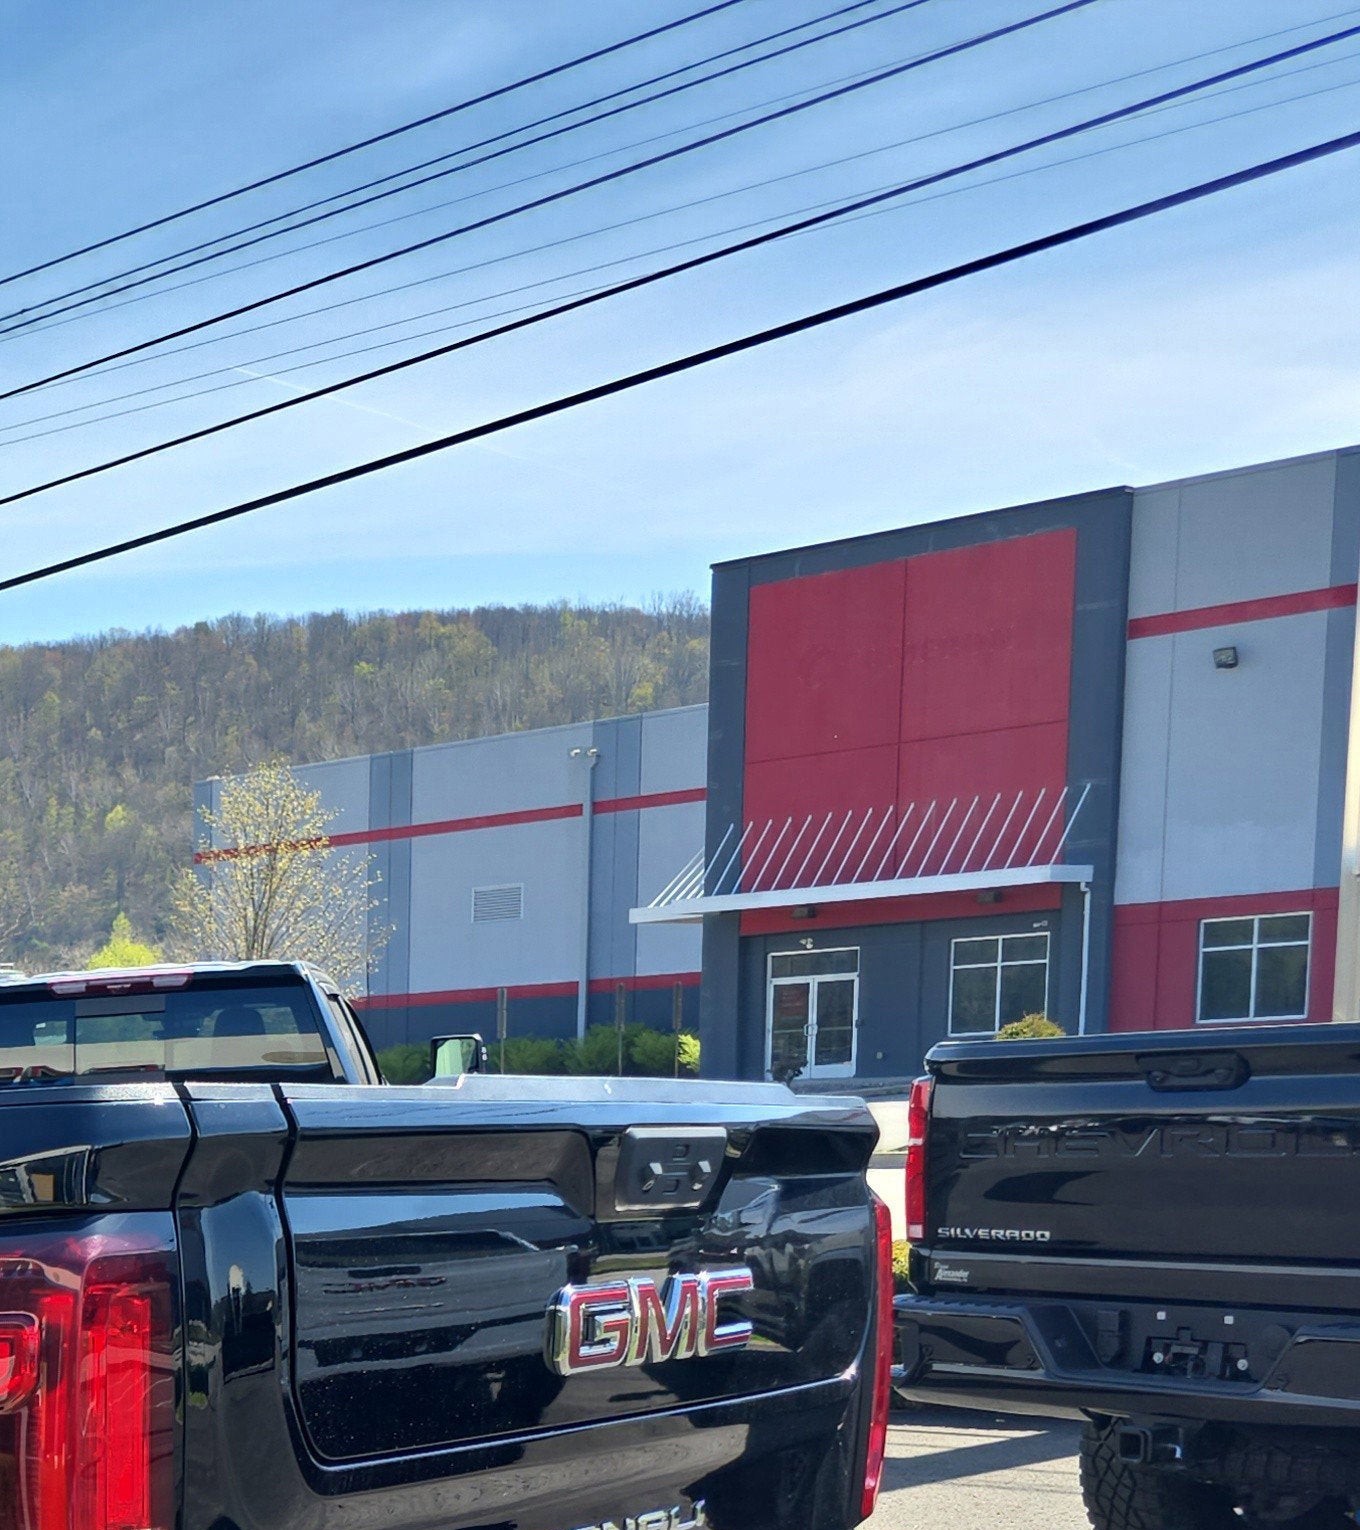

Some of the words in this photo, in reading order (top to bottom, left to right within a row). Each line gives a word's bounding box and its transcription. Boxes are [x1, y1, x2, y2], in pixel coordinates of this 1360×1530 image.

[960, 1127, 1360, 1160] CHEVROL
[937, 1227, 1051, 1242] SILVERADO
[544, 1267, 754, 1375] GMC
